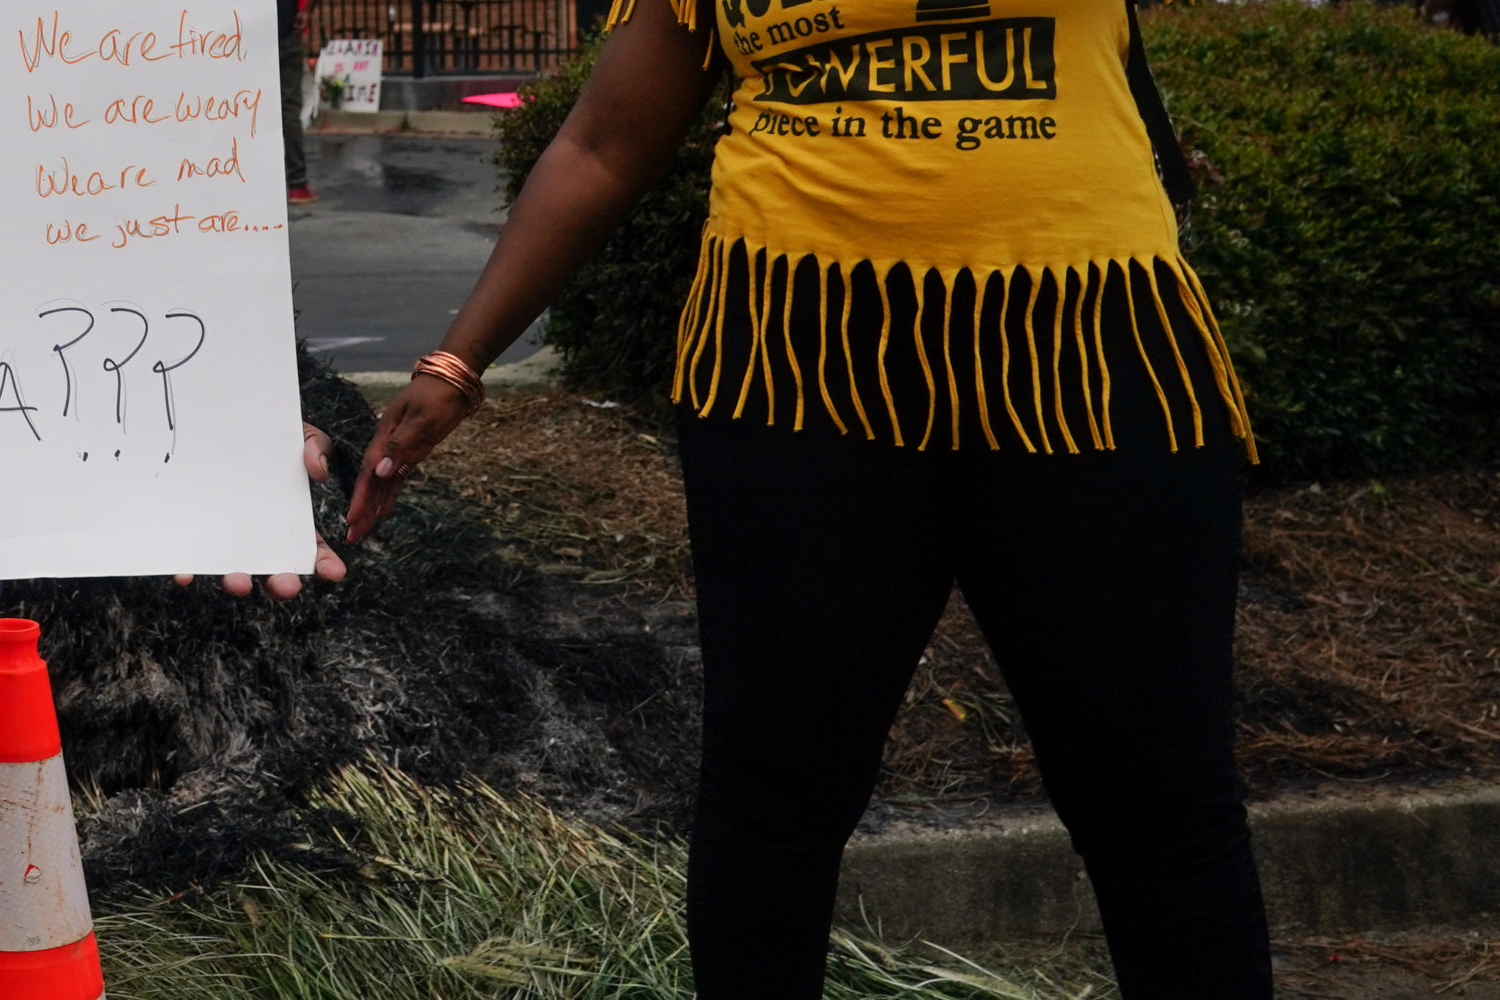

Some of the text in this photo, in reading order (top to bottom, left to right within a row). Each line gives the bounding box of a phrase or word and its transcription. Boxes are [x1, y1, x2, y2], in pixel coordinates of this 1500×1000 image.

[19, 10, 100, 73] We
[99, 28, 173, 67] are
[732, 5, 845, 56] the most
[26, 93, 91, 132] We
[104, 95, 172, 124] are
[749, 106, 1058, 152] piece in the game
[86, 165, 156, 196] are
[177, 136, 246, 183] mad
[111, 202, 196, 249] just
